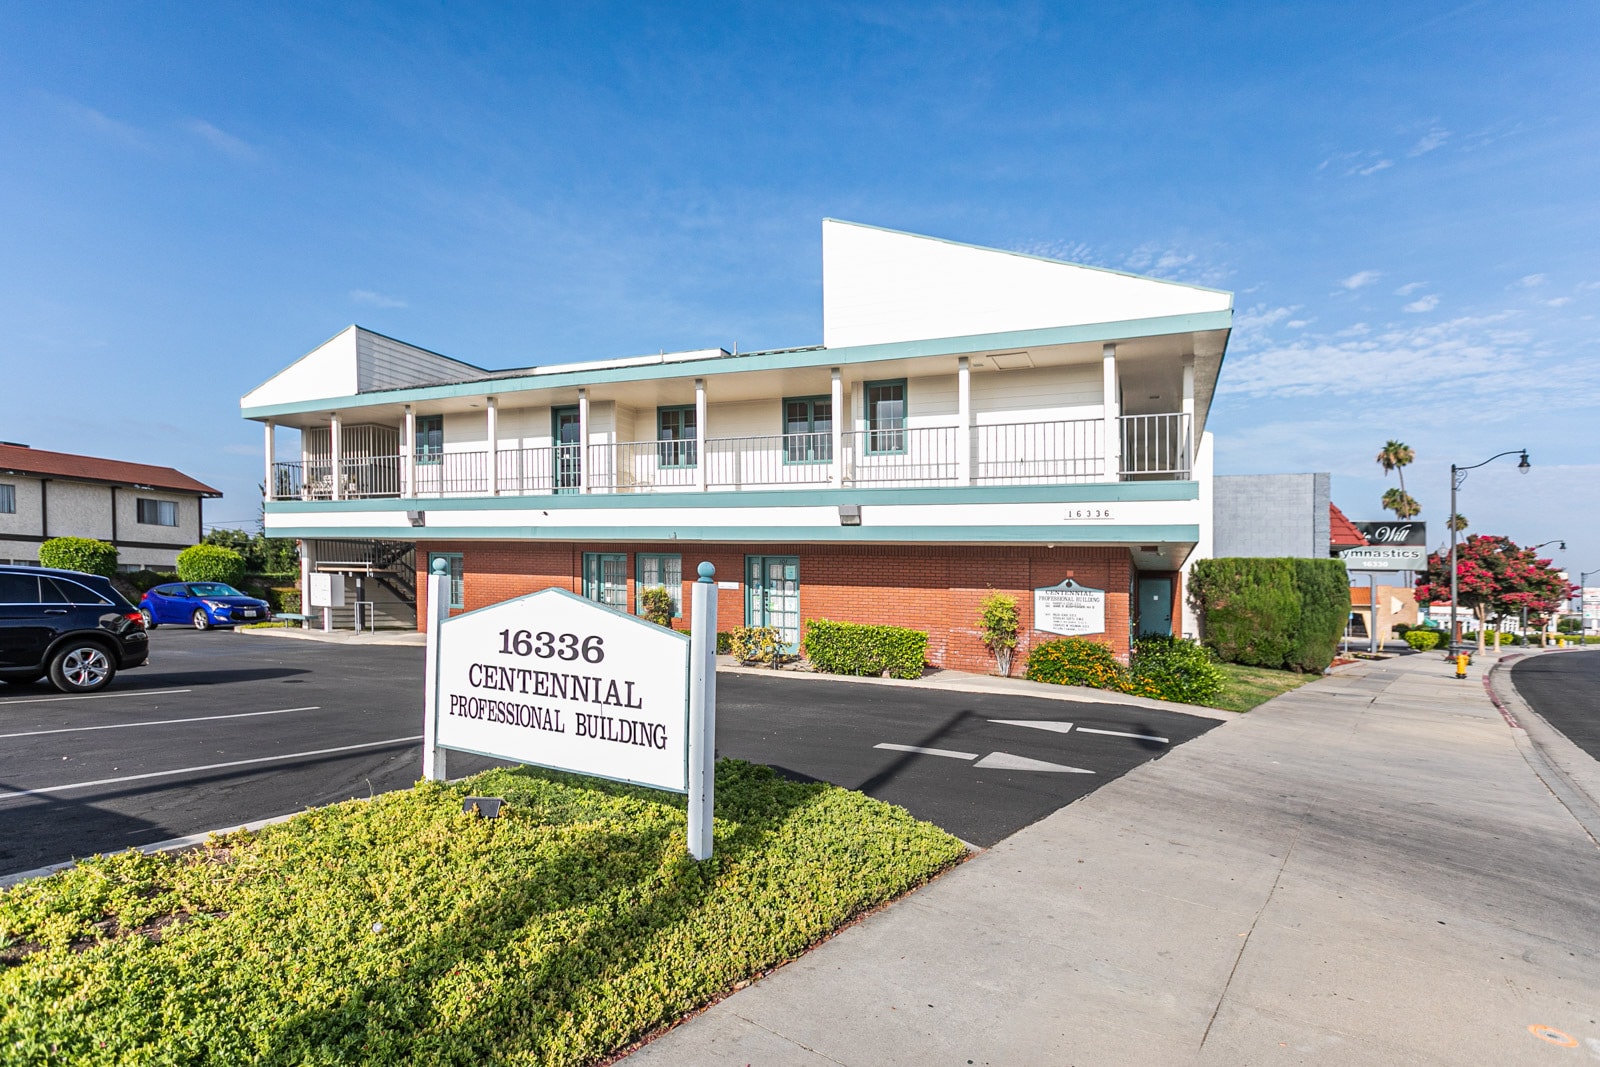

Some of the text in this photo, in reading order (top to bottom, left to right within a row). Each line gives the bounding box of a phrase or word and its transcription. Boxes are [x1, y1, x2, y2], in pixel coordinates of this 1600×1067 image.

[1068, 509, 1110, 518] 16336
[1375, 524, 1412, 542] Will
[1341, 549, 1420, 559] ymnastics
[498, 628, 605, 664] 16336
[468, 663, 643, 710] CENTENNIAL
[449, 694, 668, 750] PROFESSIONAL BUILDING
